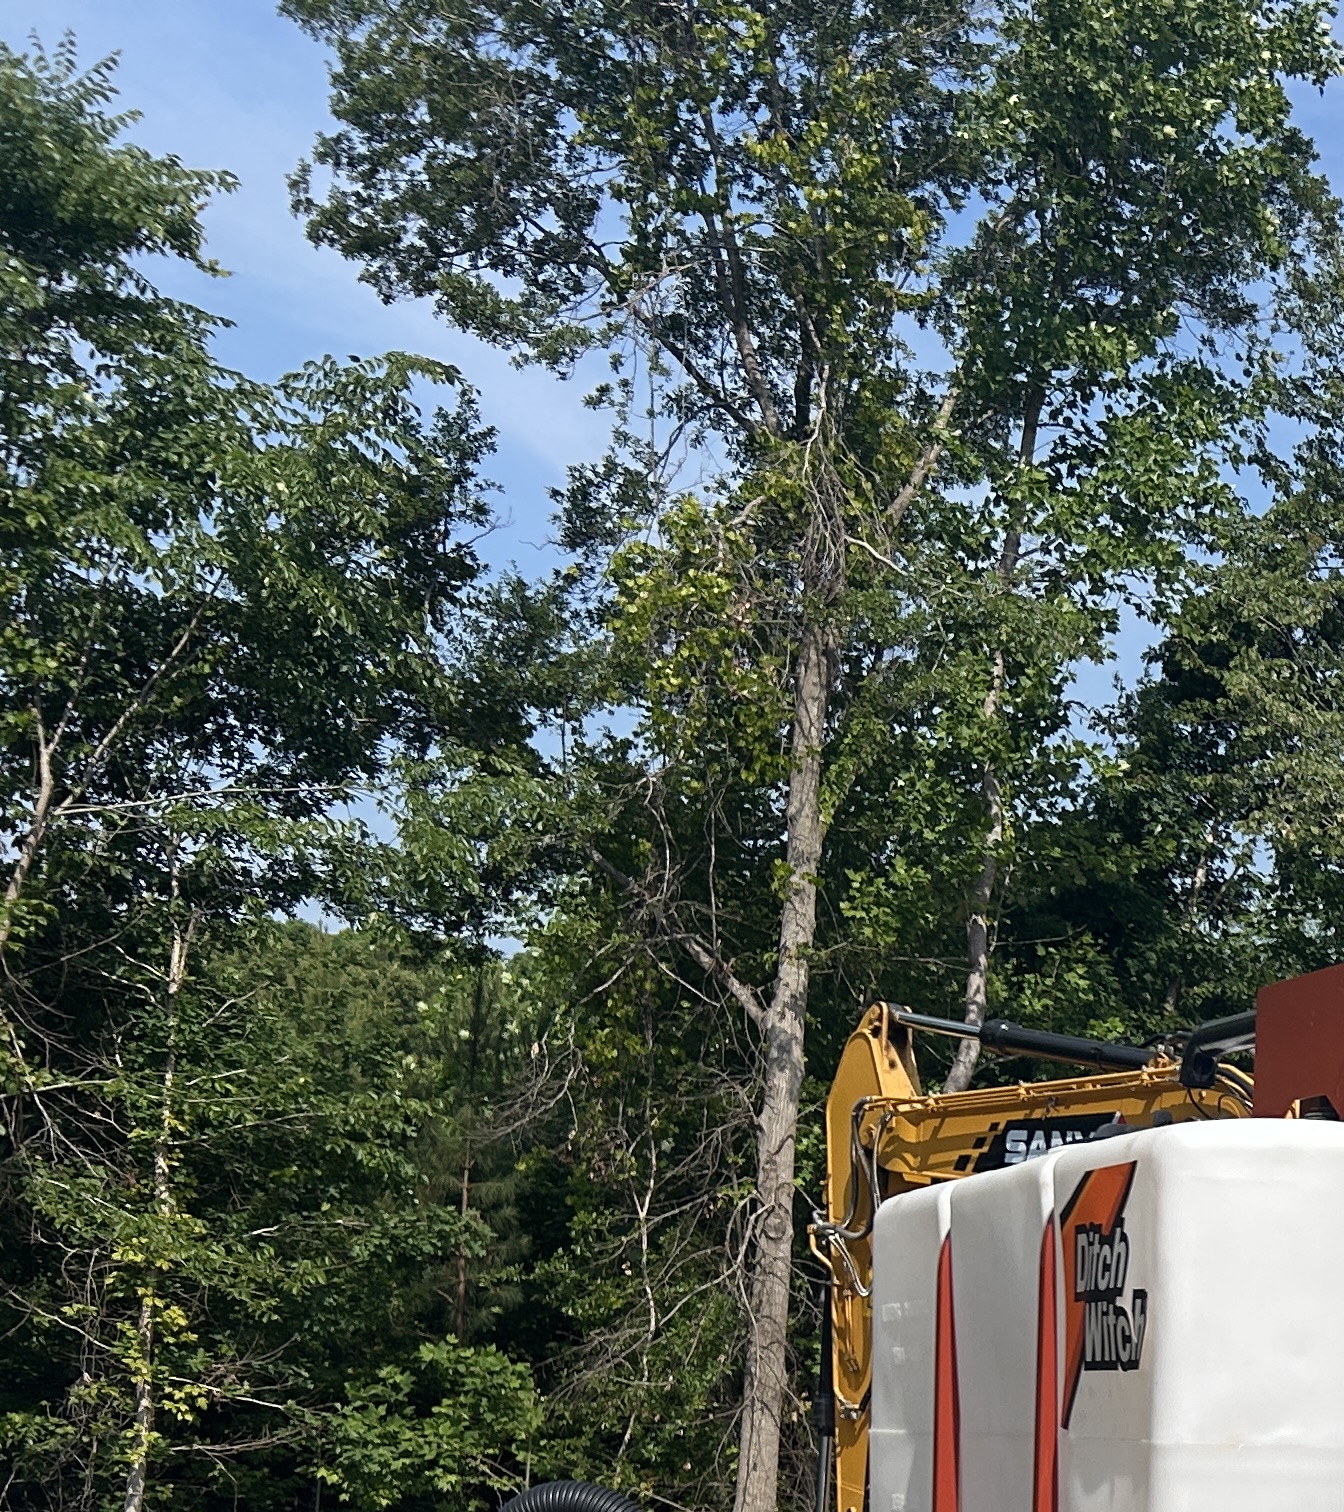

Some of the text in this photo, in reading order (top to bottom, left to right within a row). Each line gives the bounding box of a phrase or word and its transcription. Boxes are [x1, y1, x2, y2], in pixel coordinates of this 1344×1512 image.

[1004, 1129, 1096, 1163] SAN
[1076, 1226, 1128, 1293] Ditch
[1085, 1298, 1145, 1363] Witch
